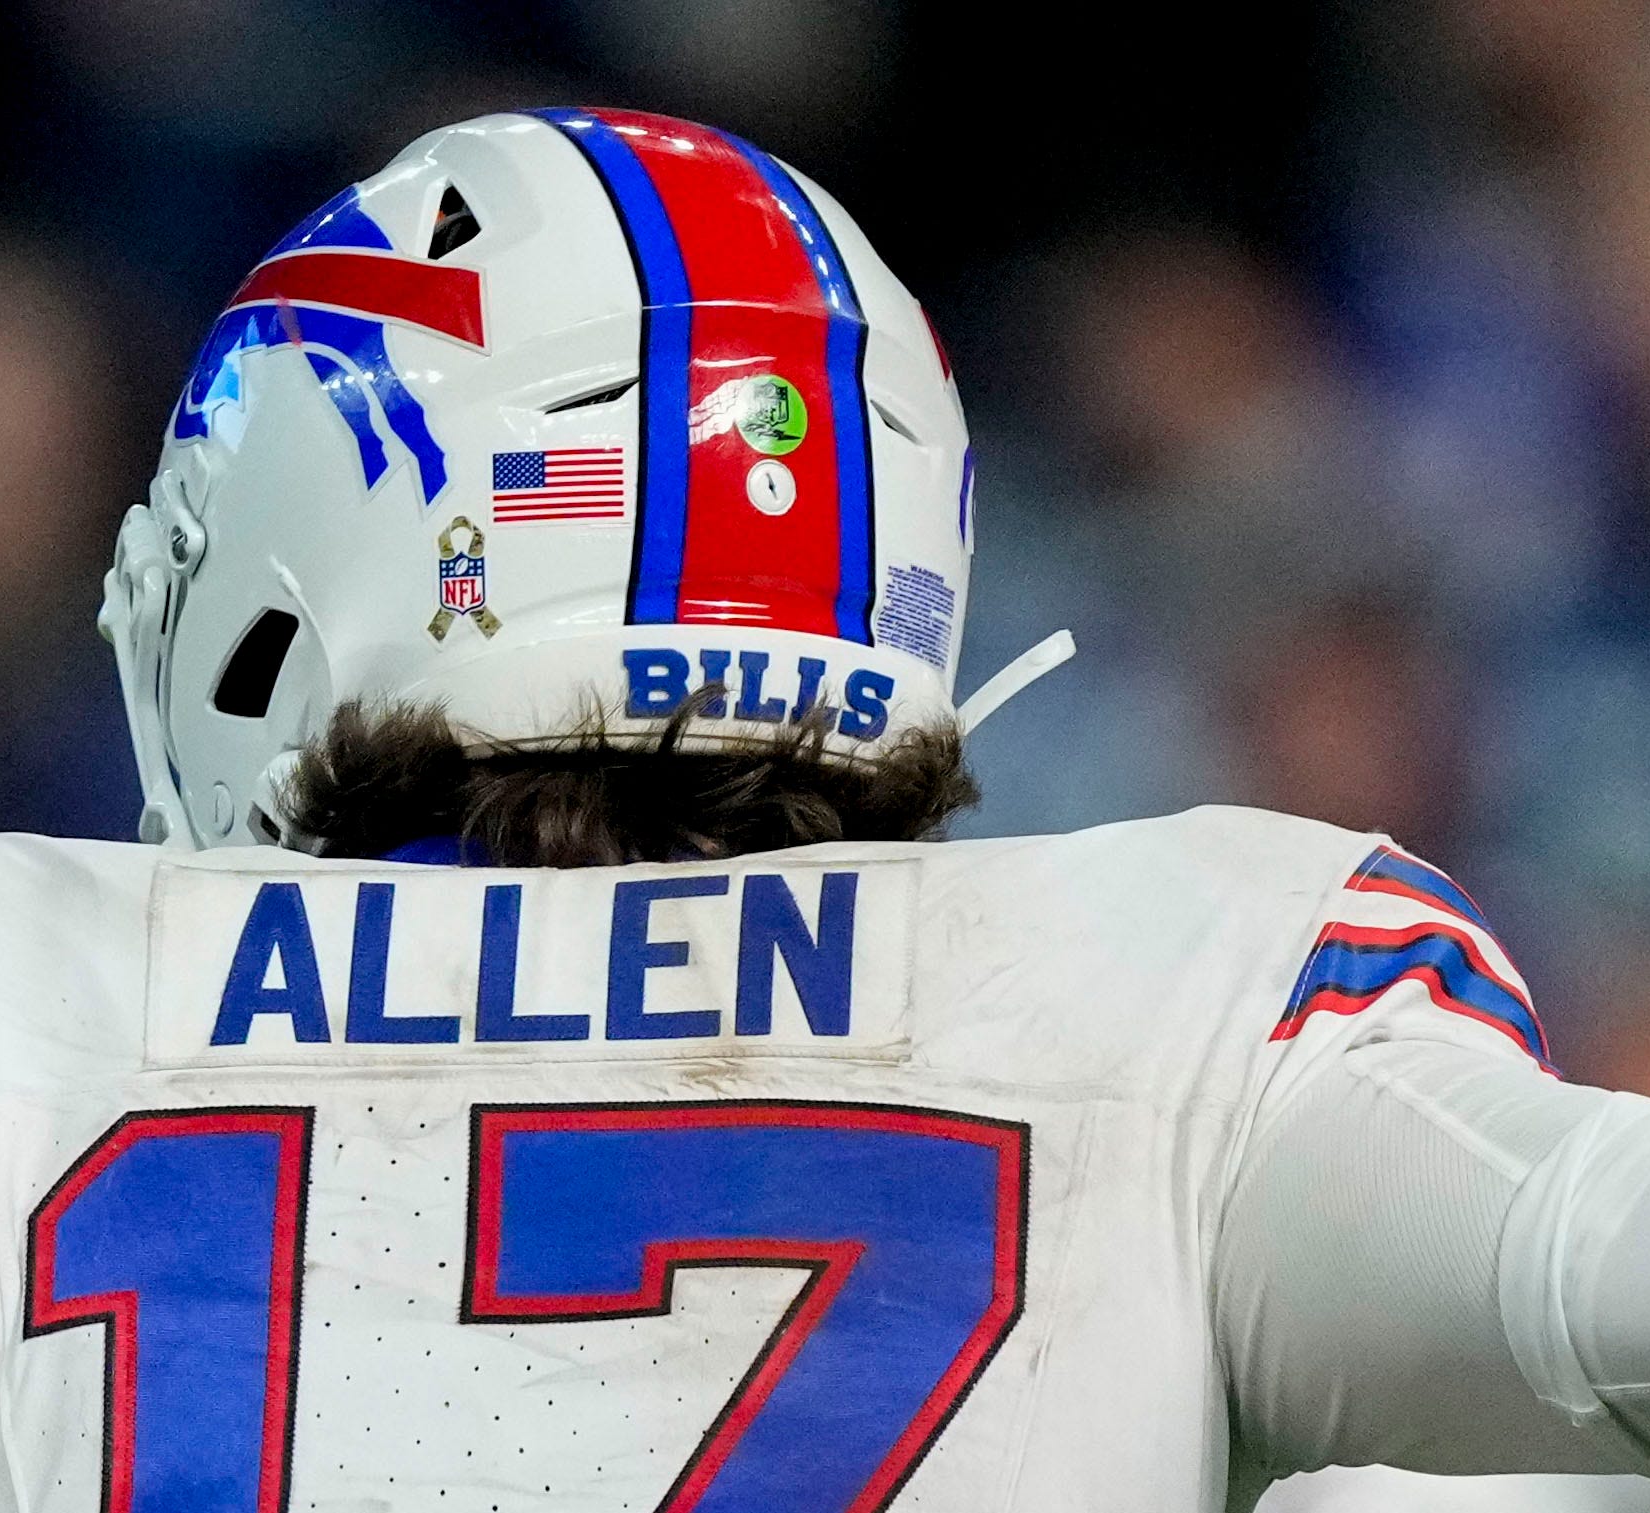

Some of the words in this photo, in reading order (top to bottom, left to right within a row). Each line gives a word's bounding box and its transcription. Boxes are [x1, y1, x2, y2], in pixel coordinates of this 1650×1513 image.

[443, 578, 482, 608] NFL
[622, 648, 895, 742] BILLS
[210, 872, 860, 1046] ALLEN
